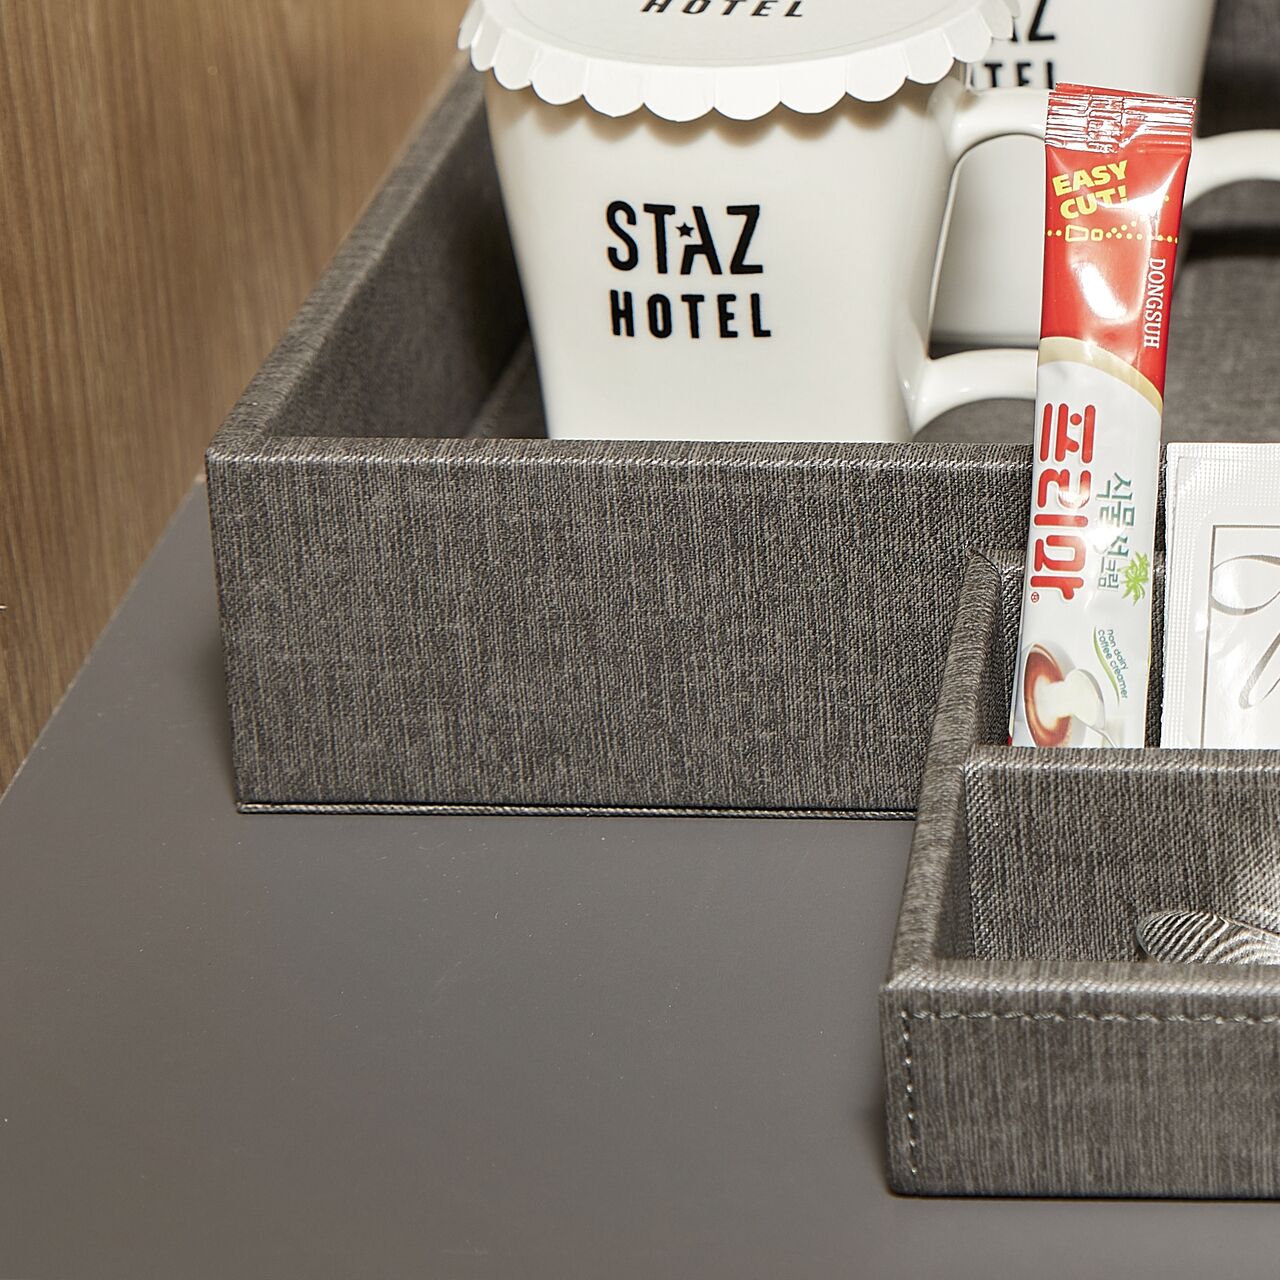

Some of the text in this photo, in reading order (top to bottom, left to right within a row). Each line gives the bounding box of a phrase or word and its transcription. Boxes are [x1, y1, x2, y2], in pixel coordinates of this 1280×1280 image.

[1052, 159, 1129, 197] EASY
[1060, 185, 1129, 220] CUT!
[606, 200, 764, 276] STAZ
[609, 290, 772, 339] HOTEL
[1143, 257, 1167, 349] DONGSUH
[1030, 403, 1096, 601] 프리마
[1098, 629, 1129, 699] coffee creamer
[1107, 628, 1129, 671] non dairy
